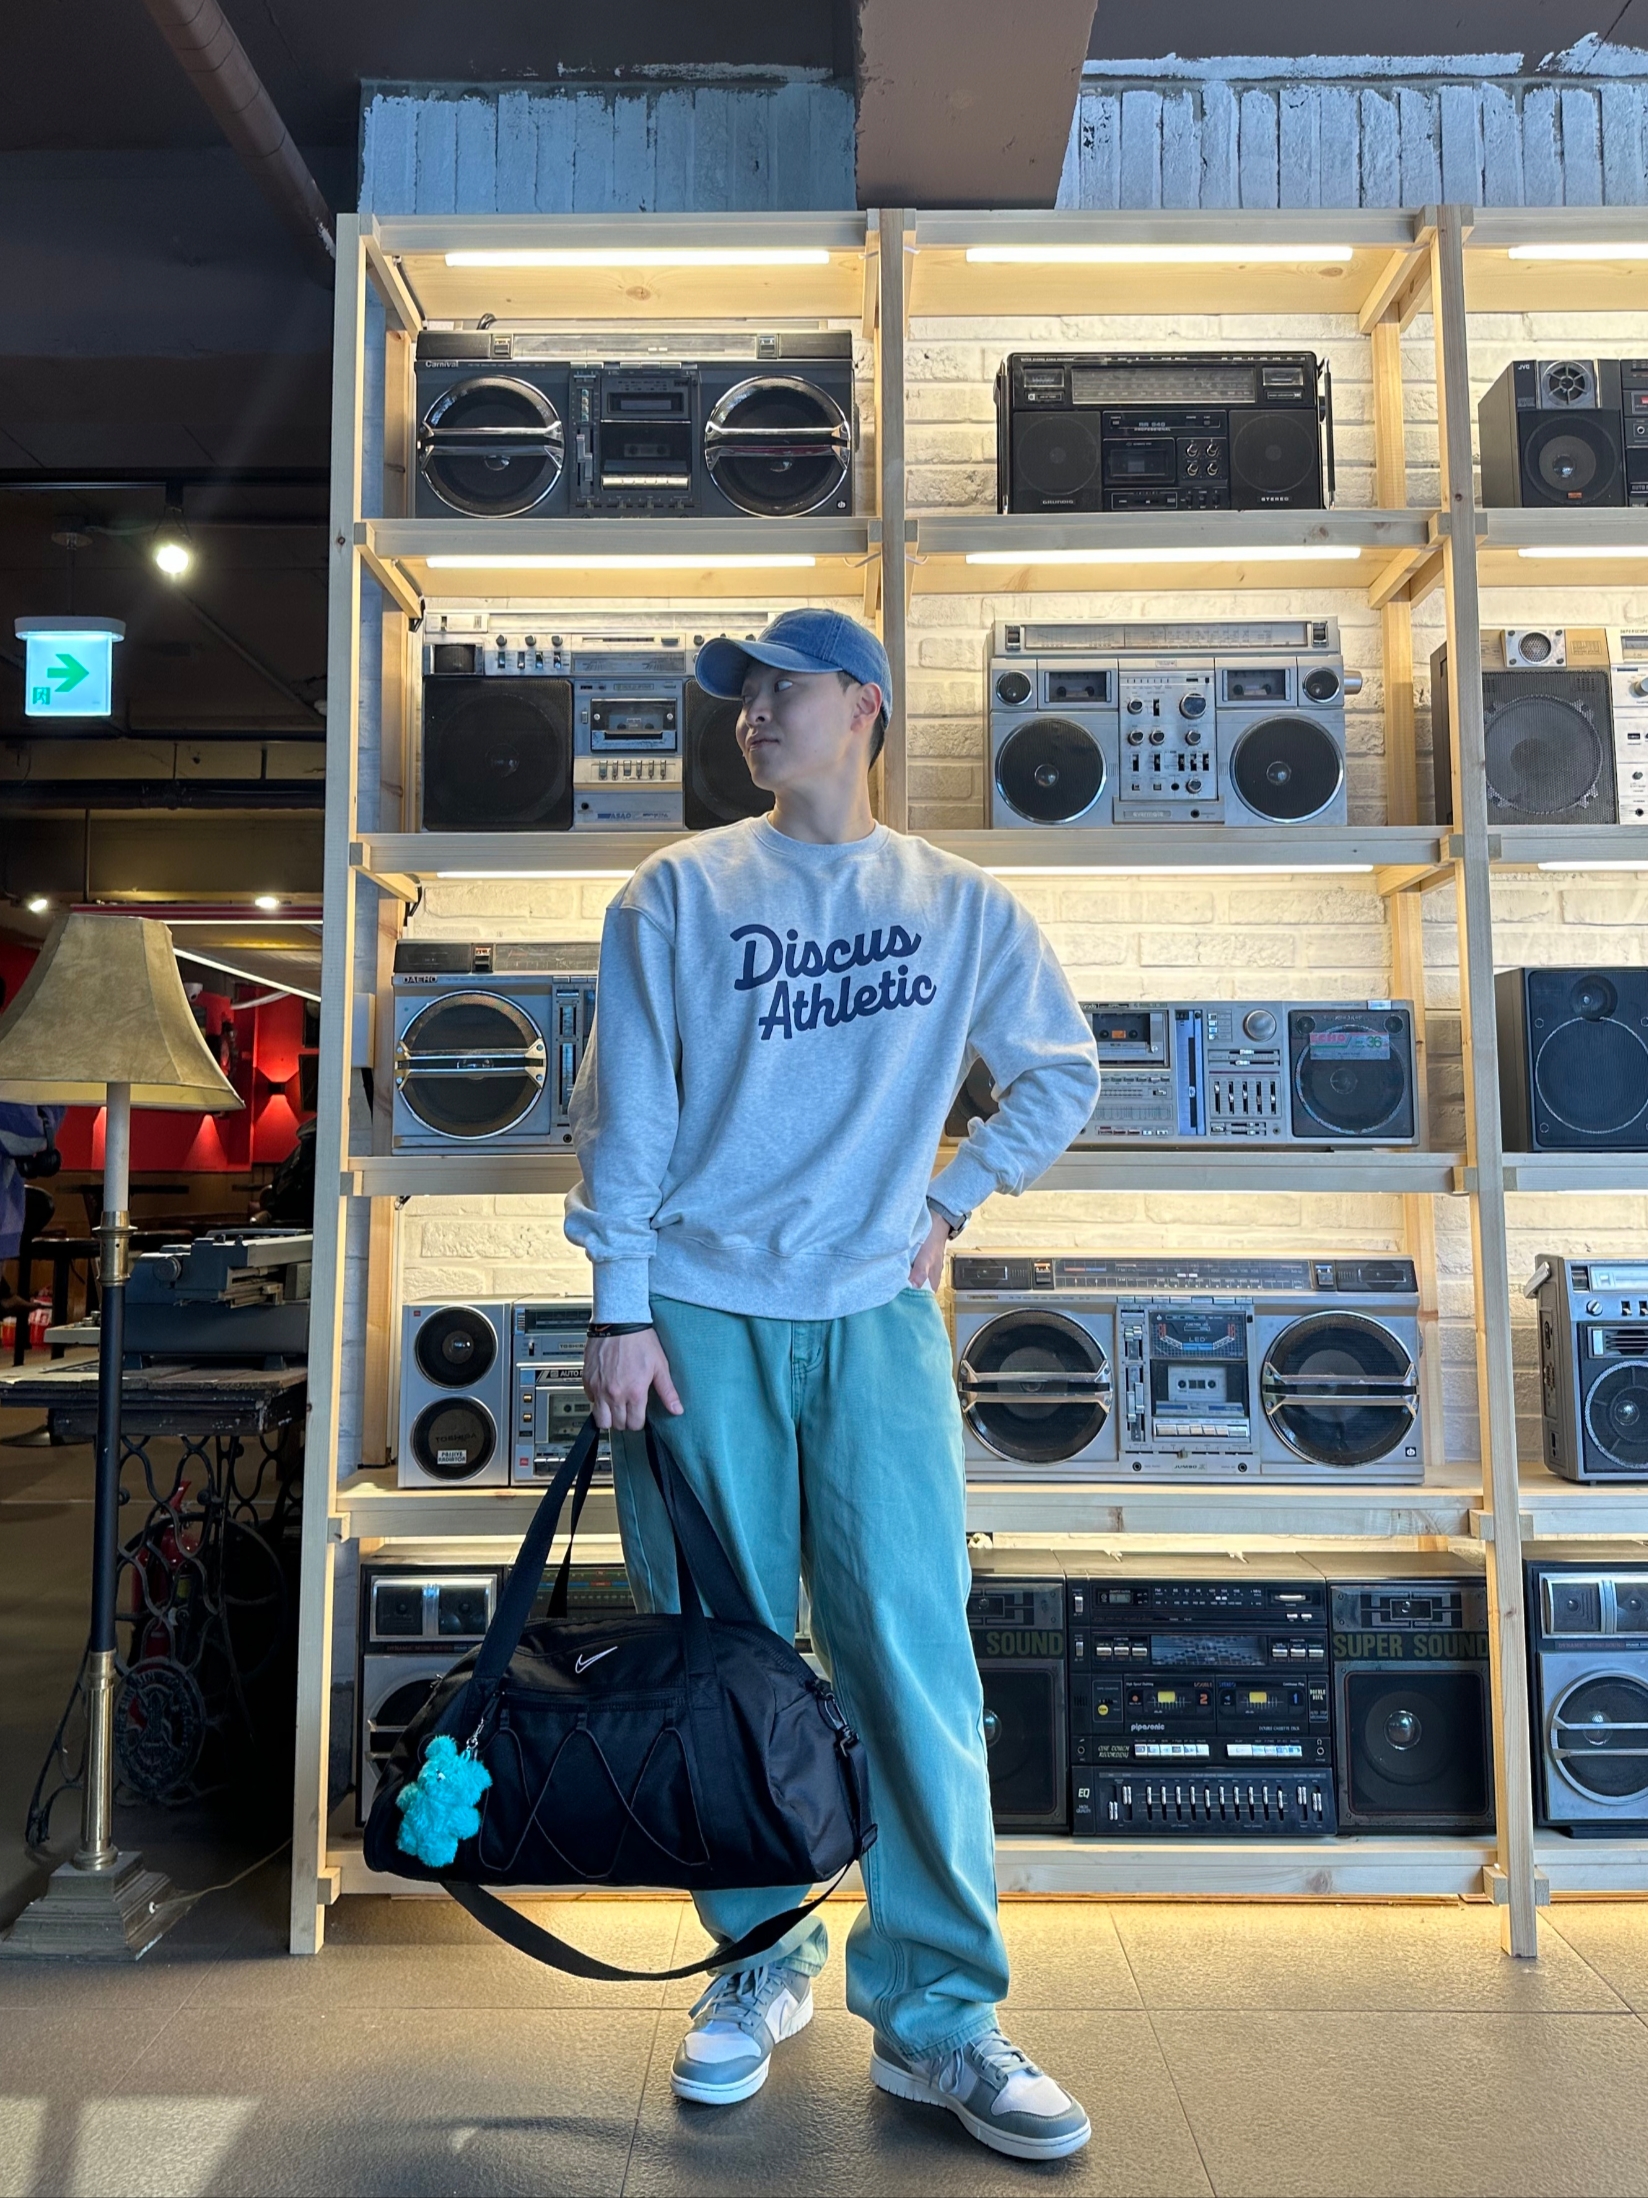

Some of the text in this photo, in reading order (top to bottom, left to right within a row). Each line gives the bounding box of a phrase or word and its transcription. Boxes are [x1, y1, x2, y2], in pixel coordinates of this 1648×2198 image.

[425, 359, 459, 368] Carnival
[730, 923, 922, 991] Discus
[758, 964, 937, 1040] Athletic
[1366, 1035, 1383, 1048] 36
[435, 1432, 477, 1443] TOSHIBA
[986, 1631, 1063, 1655] SOUND
[1332, 1633, 1489, 1658] SUPER SOUND
[1199, 1693, 1208, 1705] 2
[1292, 1693, 1299, 1704] 1
[1078, 1787, 1091, 1798] EQ
